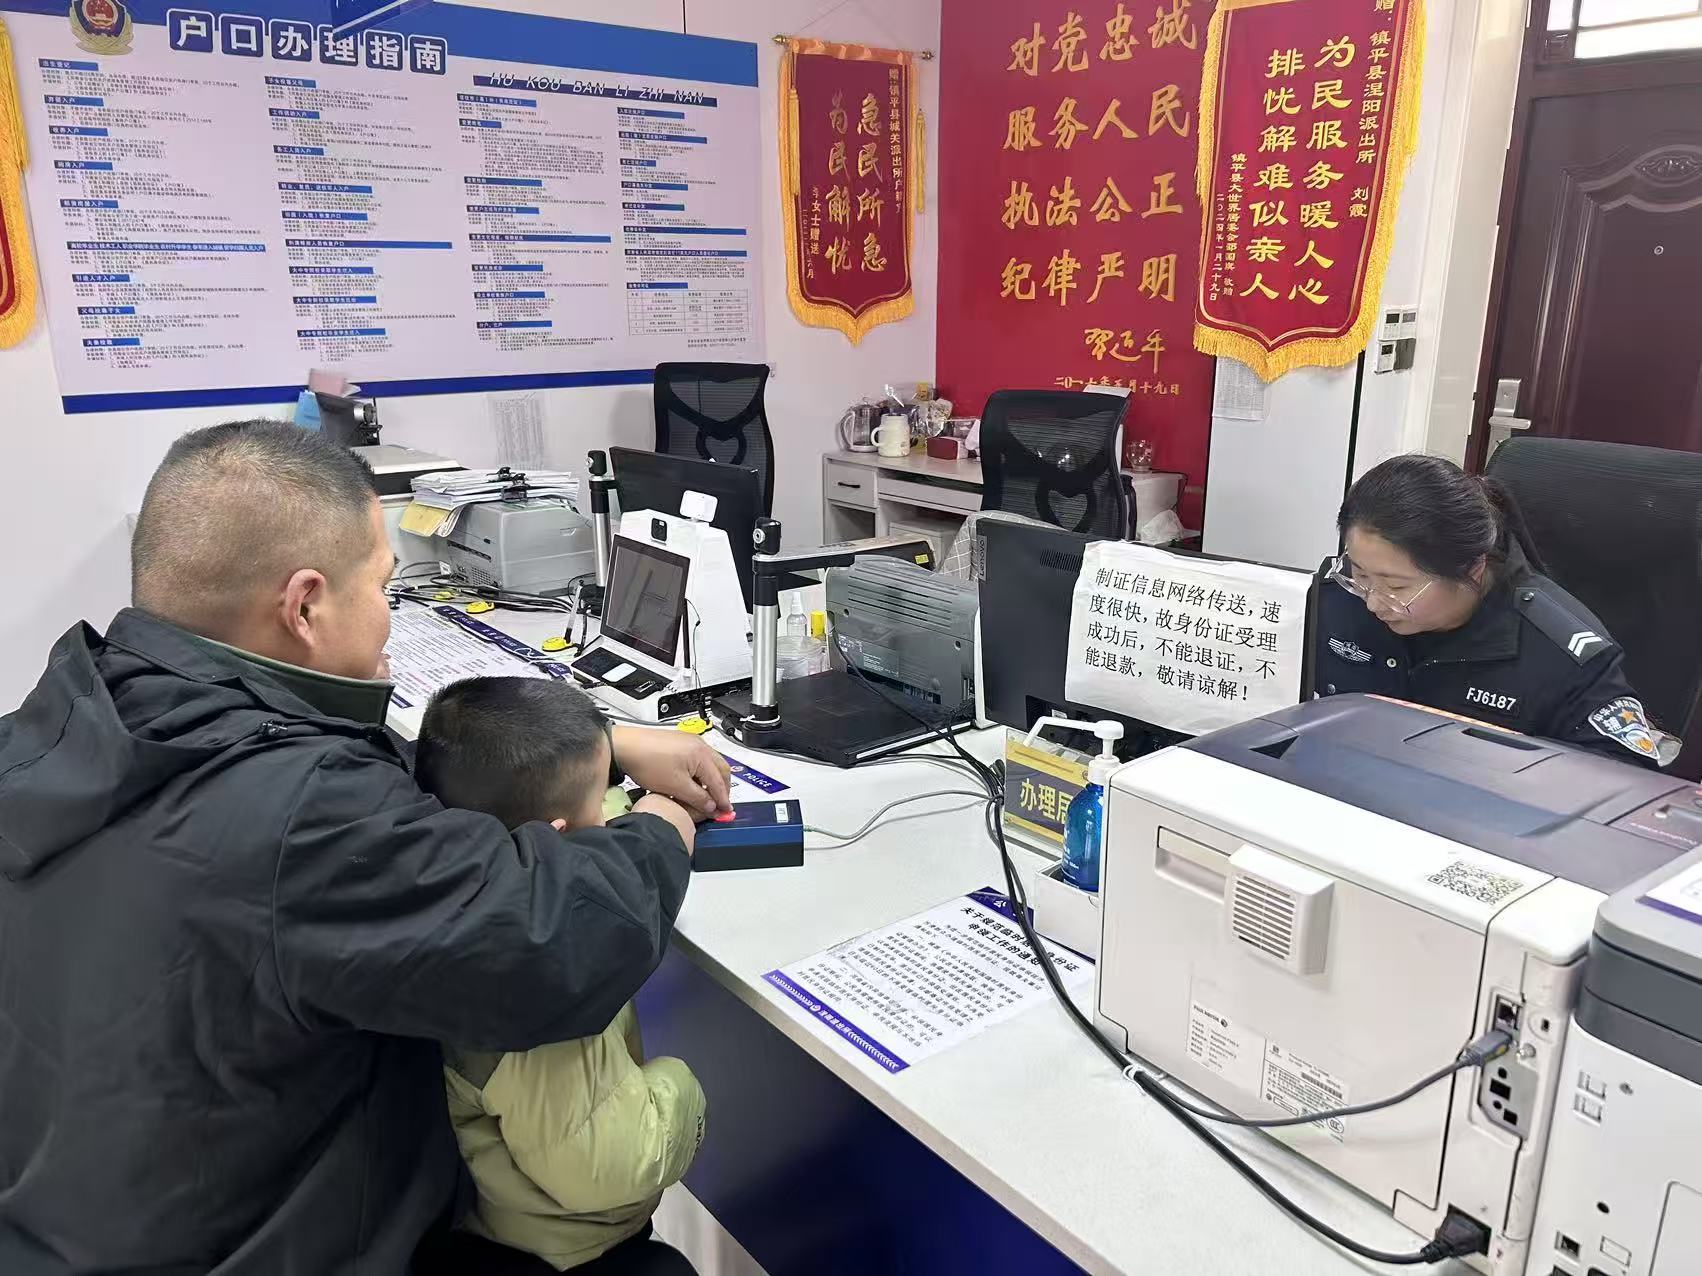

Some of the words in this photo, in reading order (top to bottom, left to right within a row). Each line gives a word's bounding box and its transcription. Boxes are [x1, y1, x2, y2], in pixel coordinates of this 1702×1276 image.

[176, 16, 442, 71] 户口办理指南
[1007, 3, 1198, 77] 对党忠诚
[490, 73, 516, 87] HU
[526, 76, 562, 91] KOU
[573, 81, 605, 95] BAN
[615, 84, 631, 96] LI
[639, 87, 664, 100] ZHI
[673, 90, 704, 103] NAN
[1003, 84, 1192, 152] 服务人民
[856, 93, 888, 272] 急民所急
[1239, 48, 1305, 301] 排忧解难似亲人
[1289, 35, 1356, 305] 为民服务暖人心
[1001, 172, 1183, 230] 执法公正
[1000, 248, 1177, 306] 纪律严明
[1088, 594, 1278, 652] 度很快，故身份证受理
[1095, 567, 1282, 624] 制证信息网络传送，速
[1085, 646, 1249, 701] 能退款，敬请谅解！
[1087, 621, 1277, 680] 成功后，不能退证，不
[1466, 687, 1516, 712] FJ6187
[743, 773, 772, 787] POLICE
[961, 906, 1079, 972] 关于规范临时居份证
